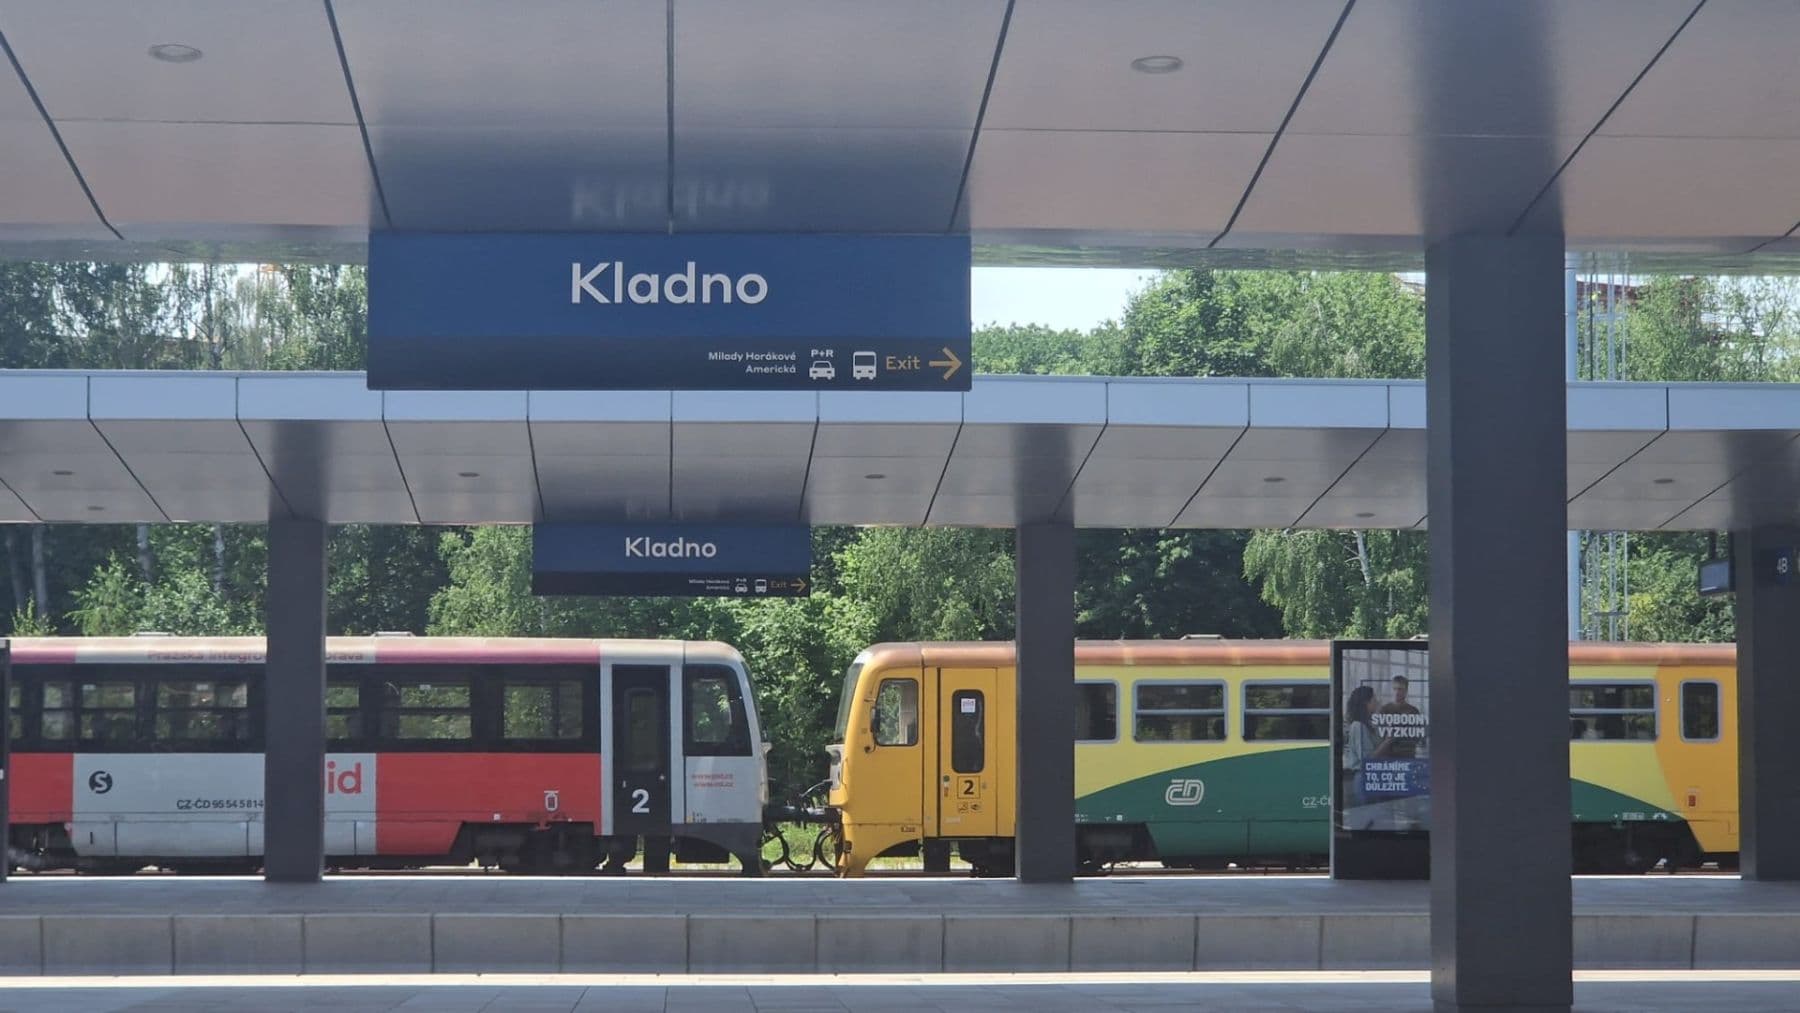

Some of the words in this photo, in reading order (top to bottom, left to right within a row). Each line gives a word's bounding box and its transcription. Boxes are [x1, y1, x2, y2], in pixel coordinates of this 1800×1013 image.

[571, 261, 768, 304] Kladno
[708, 351, 743, 361] Milady
[746, 350, 797, 360] Horákové
[811, 349, 834, 358] P+R
[745, 363, 797, 374] Americká
[886, 355, 921, 370] Exit
[625, 537, 717, 557] Kladno
[326, 760, 363, 794] id
[964, 780, 975, 795] 2
[632, 789, 650, 813] 2
